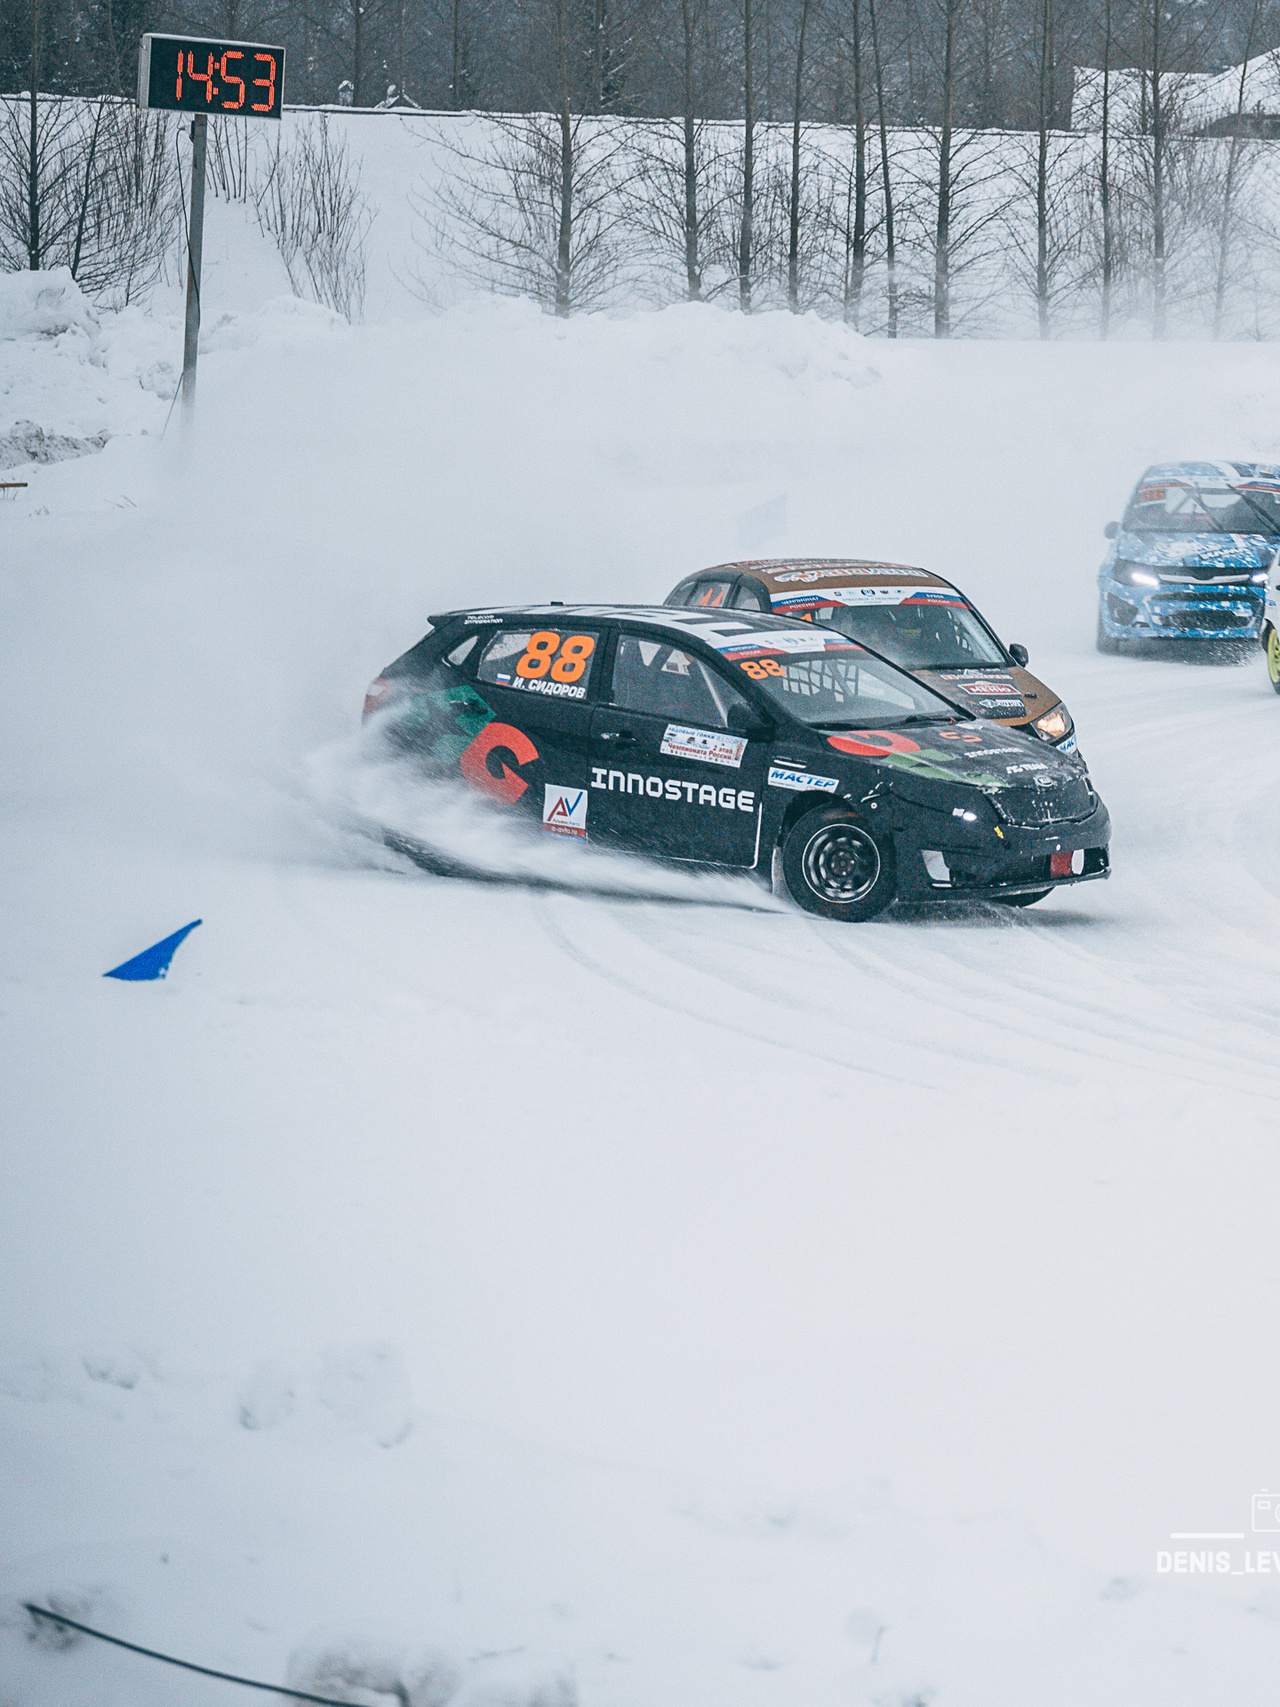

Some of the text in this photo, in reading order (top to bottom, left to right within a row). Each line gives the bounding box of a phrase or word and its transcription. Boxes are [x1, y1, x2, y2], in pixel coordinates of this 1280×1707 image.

[176, 50, 276, 112] 14:53
[781, 596, 819, 606] ЧЕМПИОНАТ
[516, 631, 595, 683] 88
[740, 659, 787, 680] 88
[512, 676, 586, 699] И. СИДОРОВ
[667, 743, 708, 756] Чемпионата
[708, 750, 732, 760] России
[712, 744, 719, 752] 2
[770, 769, 836, 788] МАСТЕР
[590, 767, 755, 813] INNOSTAGE
